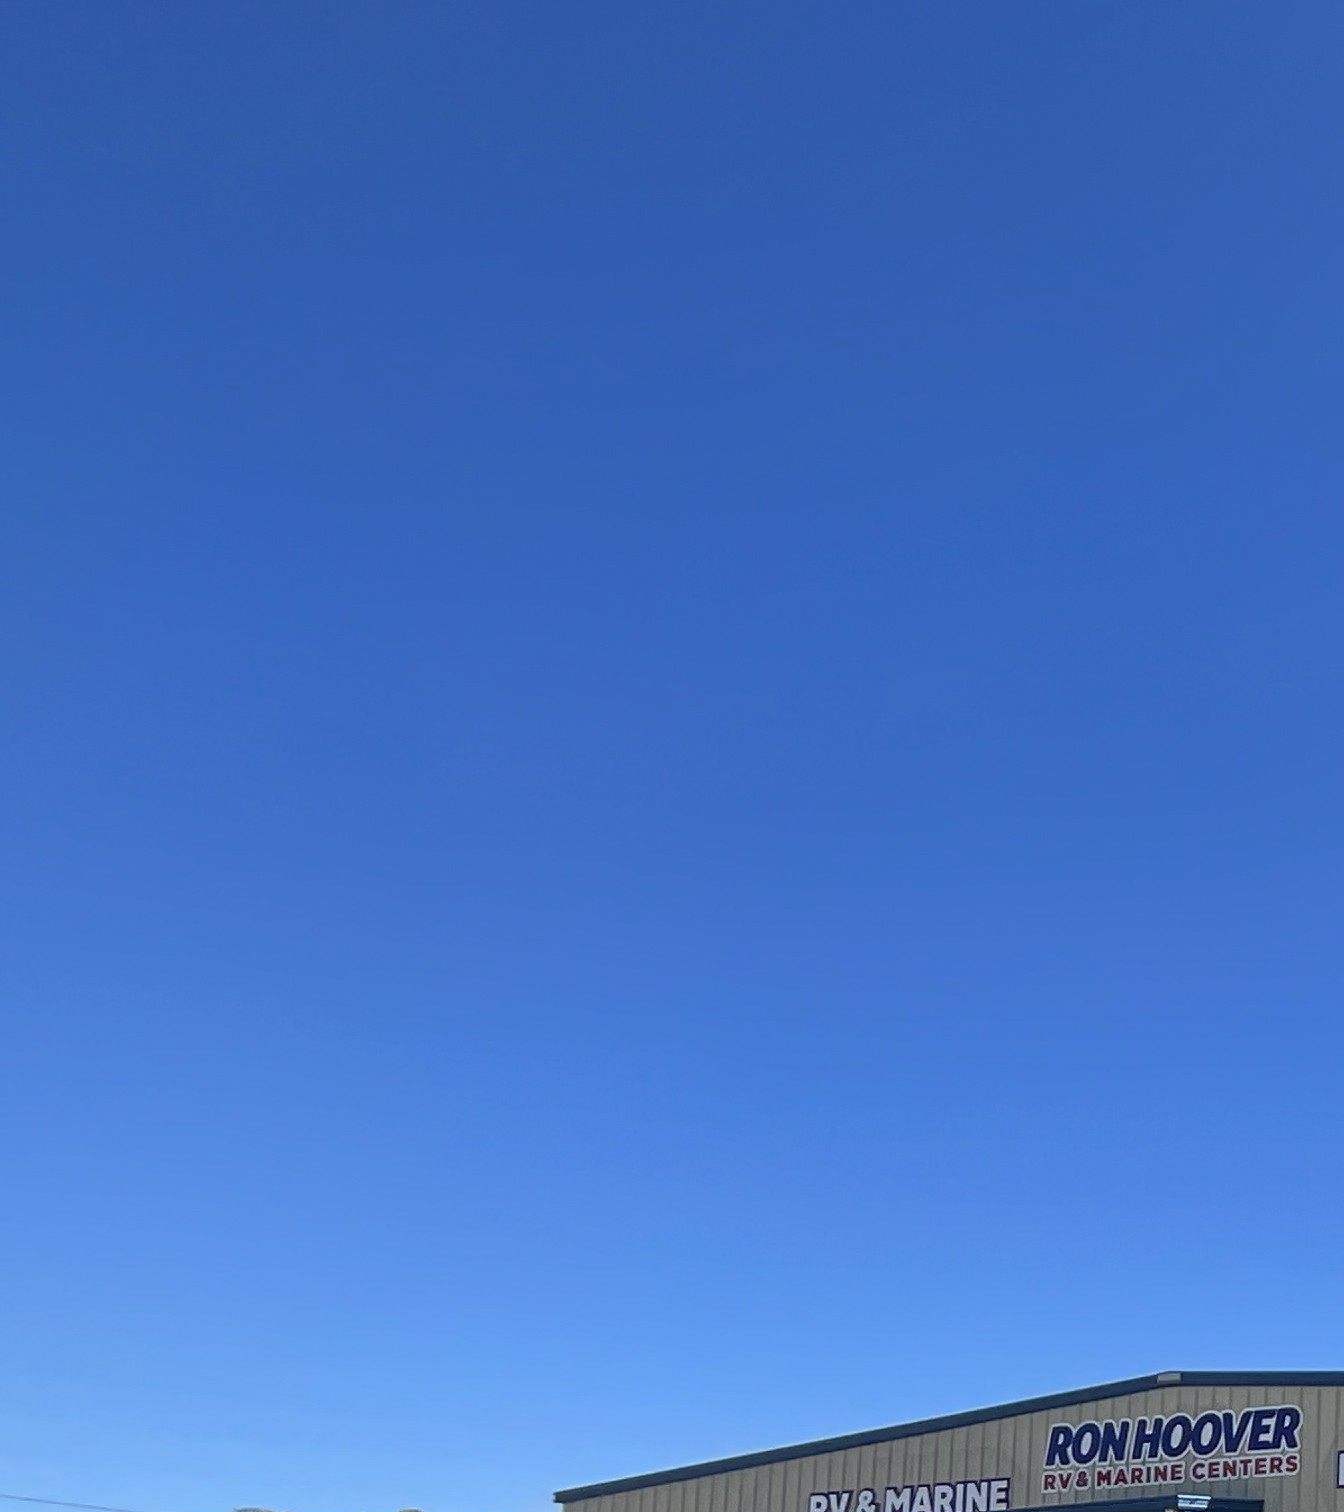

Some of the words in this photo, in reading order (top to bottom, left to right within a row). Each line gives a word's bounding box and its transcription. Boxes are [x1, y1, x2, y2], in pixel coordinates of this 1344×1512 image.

[1046, 1418, 1135, 1468] RON
[1131, 1407, 1301, 1461] HOOVER
[1044, 1471, 1073, 1491] RV
[1075, 1471, 1089, 1487] &
[1096, 1464, 1183, 1487] MARINE
[1192, 1455, 1298, 1480] CENTERS
